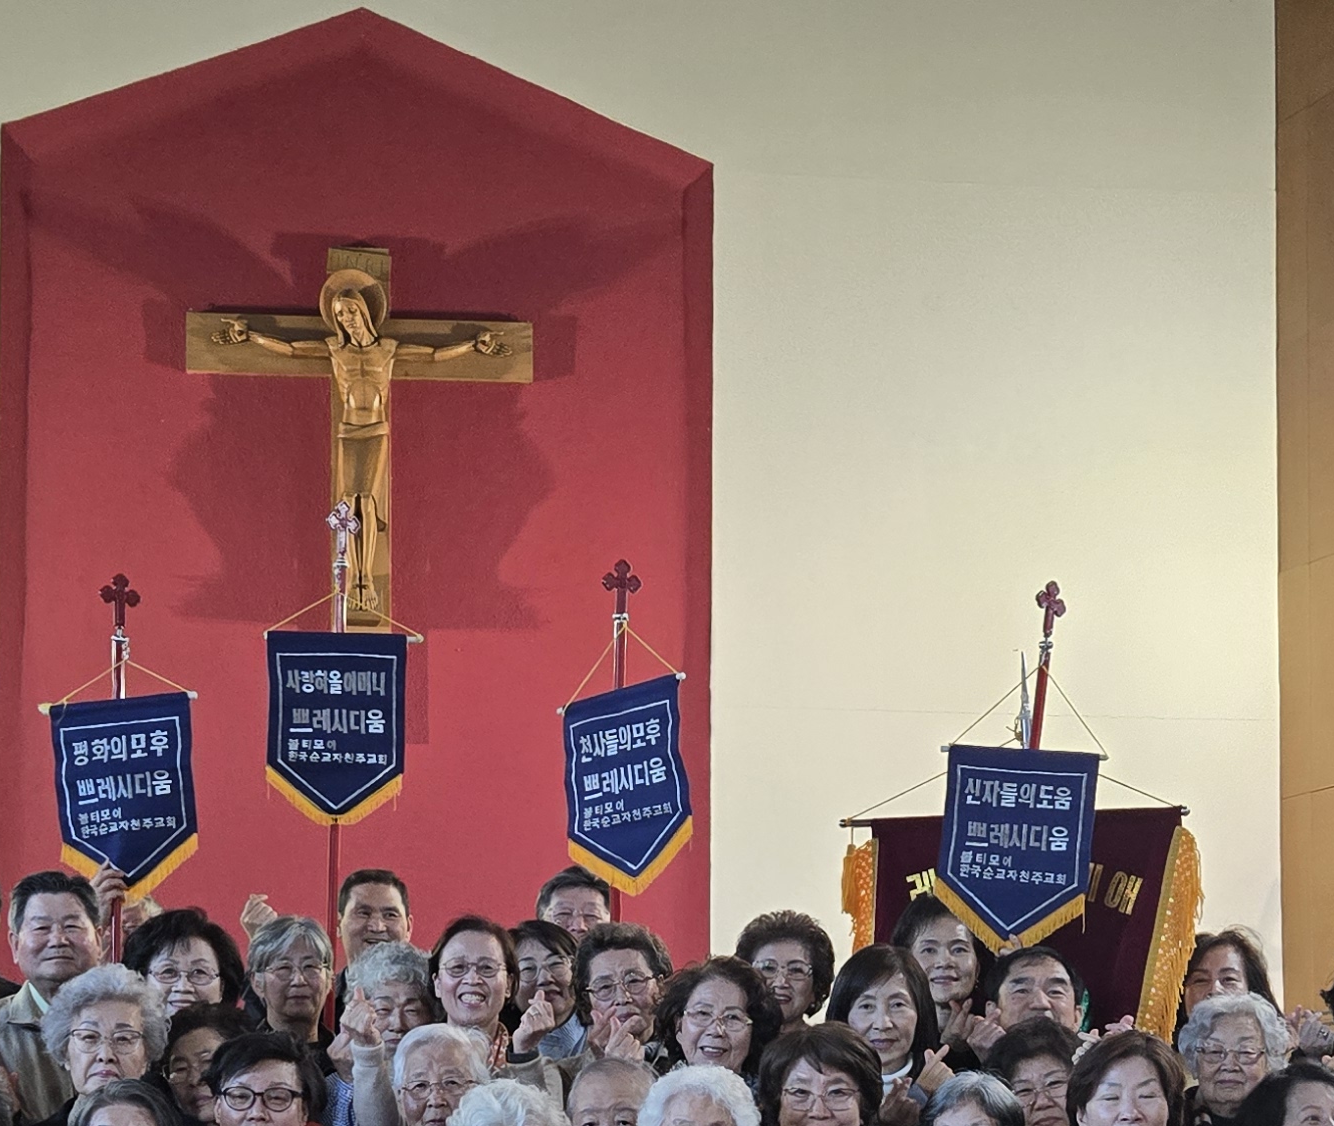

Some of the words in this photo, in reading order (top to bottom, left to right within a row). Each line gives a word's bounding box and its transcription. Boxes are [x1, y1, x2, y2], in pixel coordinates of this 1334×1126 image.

[286, 669, 386, 696] 사랑하올어머니
[289, 708, 386, 734] 쁘레시디움
[72, 730, 169, 766] 평화의모후
[287, 739, 337, 751] 볼티모어
[579, 718, 661, 763] 천사들의모후
[76, 769, 172, 805] 쁘레시디움
[583, 757, 667, 800] 쁘레시디움
[964, 778, 1072, 810] 신자들의도움
[77, 807, 122, 825] 볼티모어
[583, 799, 624, 819] 볼티모어
[965, 821, 1069, 851] 쁘레시디움
[960, 851, 1012, 867] 볼티모어
